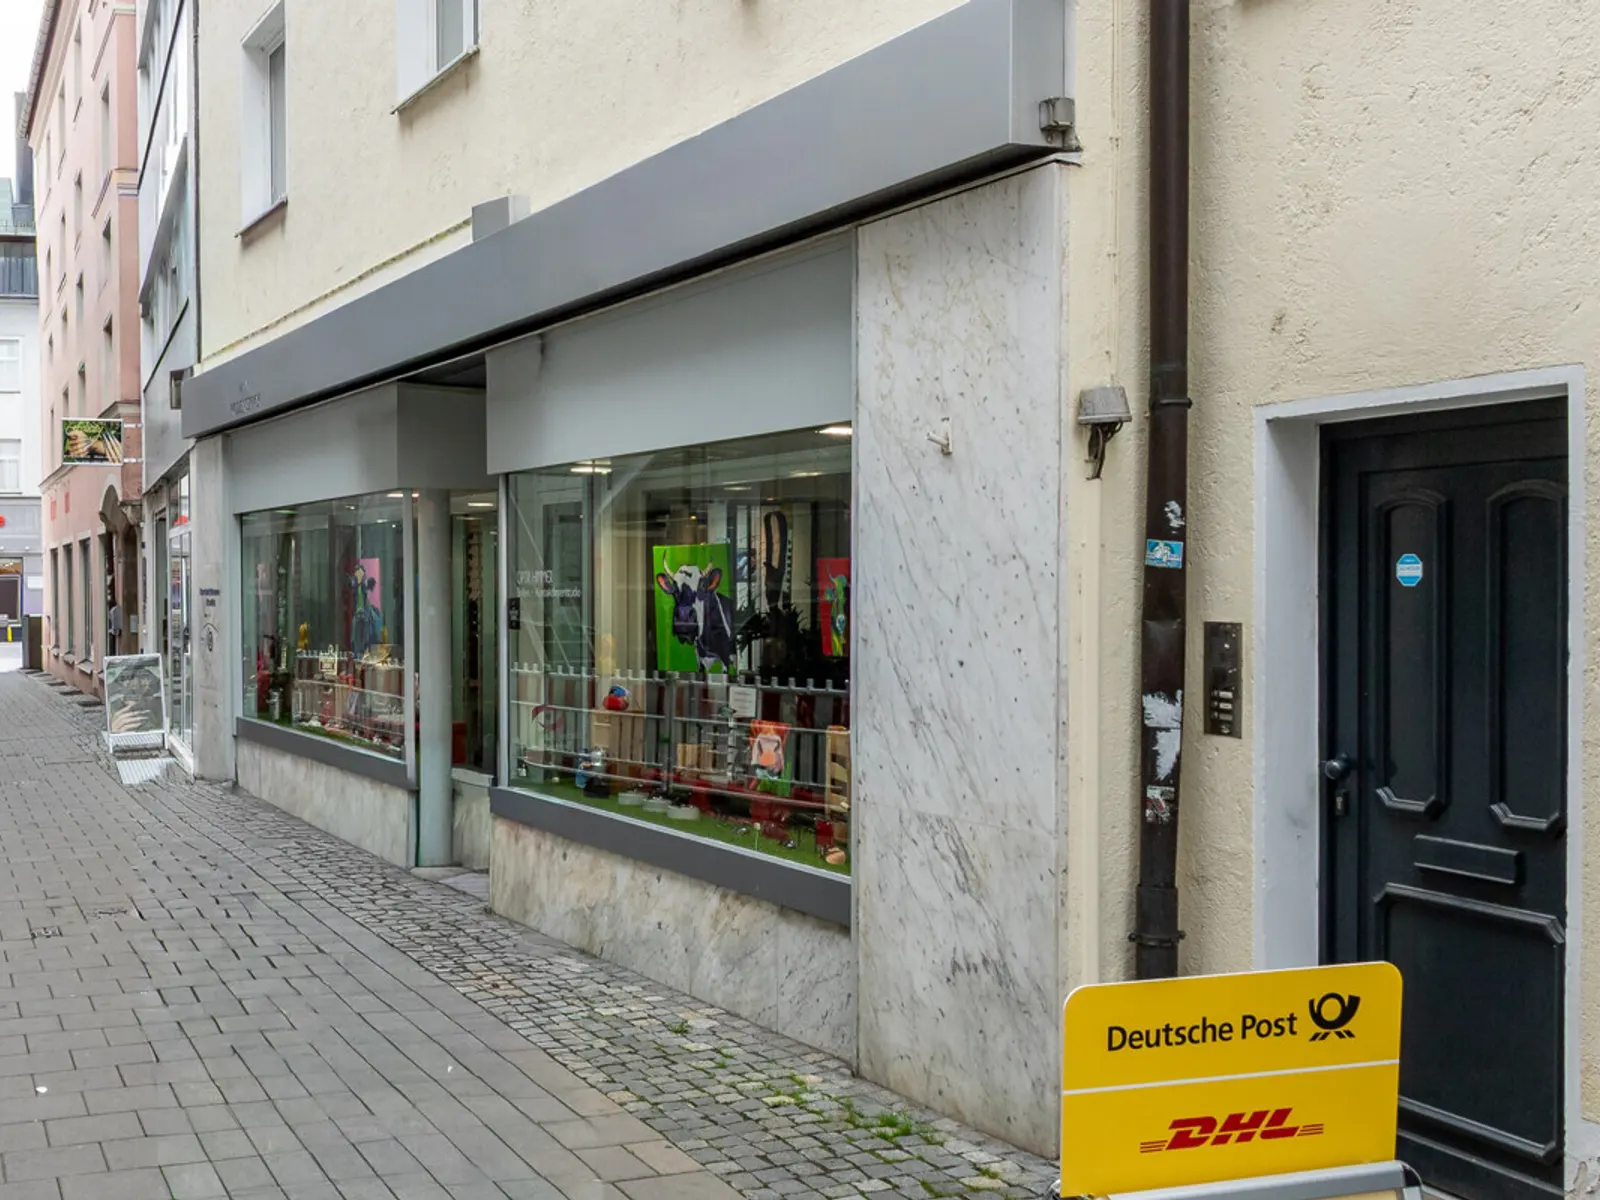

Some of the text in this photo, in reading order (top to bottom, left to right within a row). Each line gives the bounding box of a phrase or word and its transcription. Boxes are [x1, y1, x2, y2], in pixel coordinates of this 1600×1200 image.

[1107, 1012, 1298, 1052] Deutsche Post
[1165, 1107, 1300, 1151] DHL
